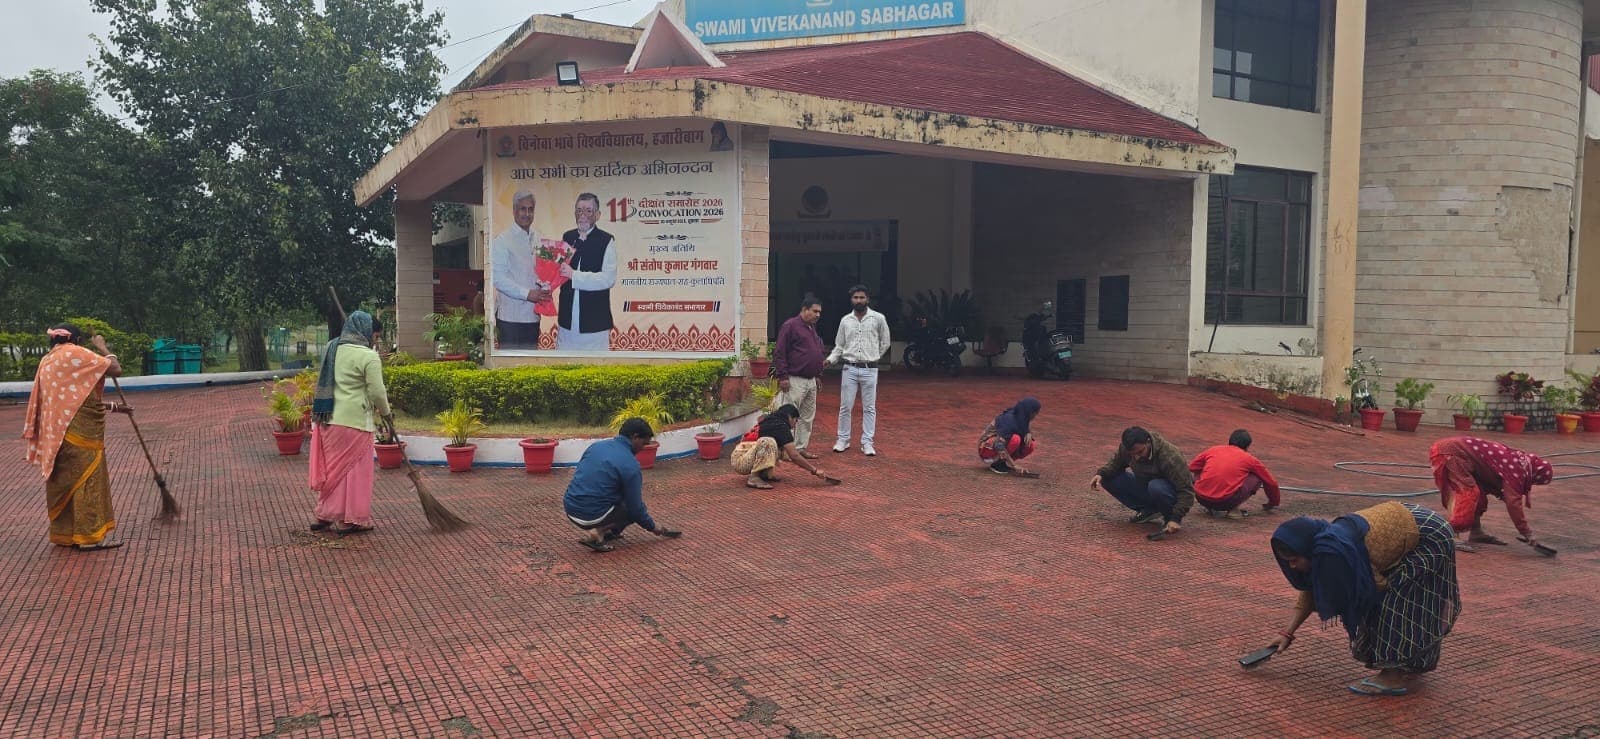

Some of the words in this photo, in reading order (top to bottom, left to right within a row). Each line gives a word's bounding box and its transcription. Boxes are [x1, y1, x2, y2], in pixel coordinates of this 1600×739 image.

[695, 19, 746, 38] SWAMI
[750, 10, 856, 34] VIVEKANAND
[860, 1, 955, 26] SABHAGAR
[554, 134, 575, 150] भावे
[653, 128, 705, 146] हजारीबाग
[511, 166, 536, 180] आप
[539, 162, 567, 180] सभी
[569, 164, 590, 178] का
[594, 159, 637, 178] हार्दिक
[641, 159, 713, 175] अभिनन्दन
[638, 197, 665, 209] दीक्षांत
[667, 197, 699, 208] समारोह
[702, 198, 723, 207] 2026
[638, 209, 701, 218] CONVOCATION
[703, 208, 724, 216] 2026
[627, 258, 639, 271] श्री
[639, 258, 663, 271] संतोष
[664, 260, 689, 273] कुमार
[690, 258, 719, 270] गंगवार
